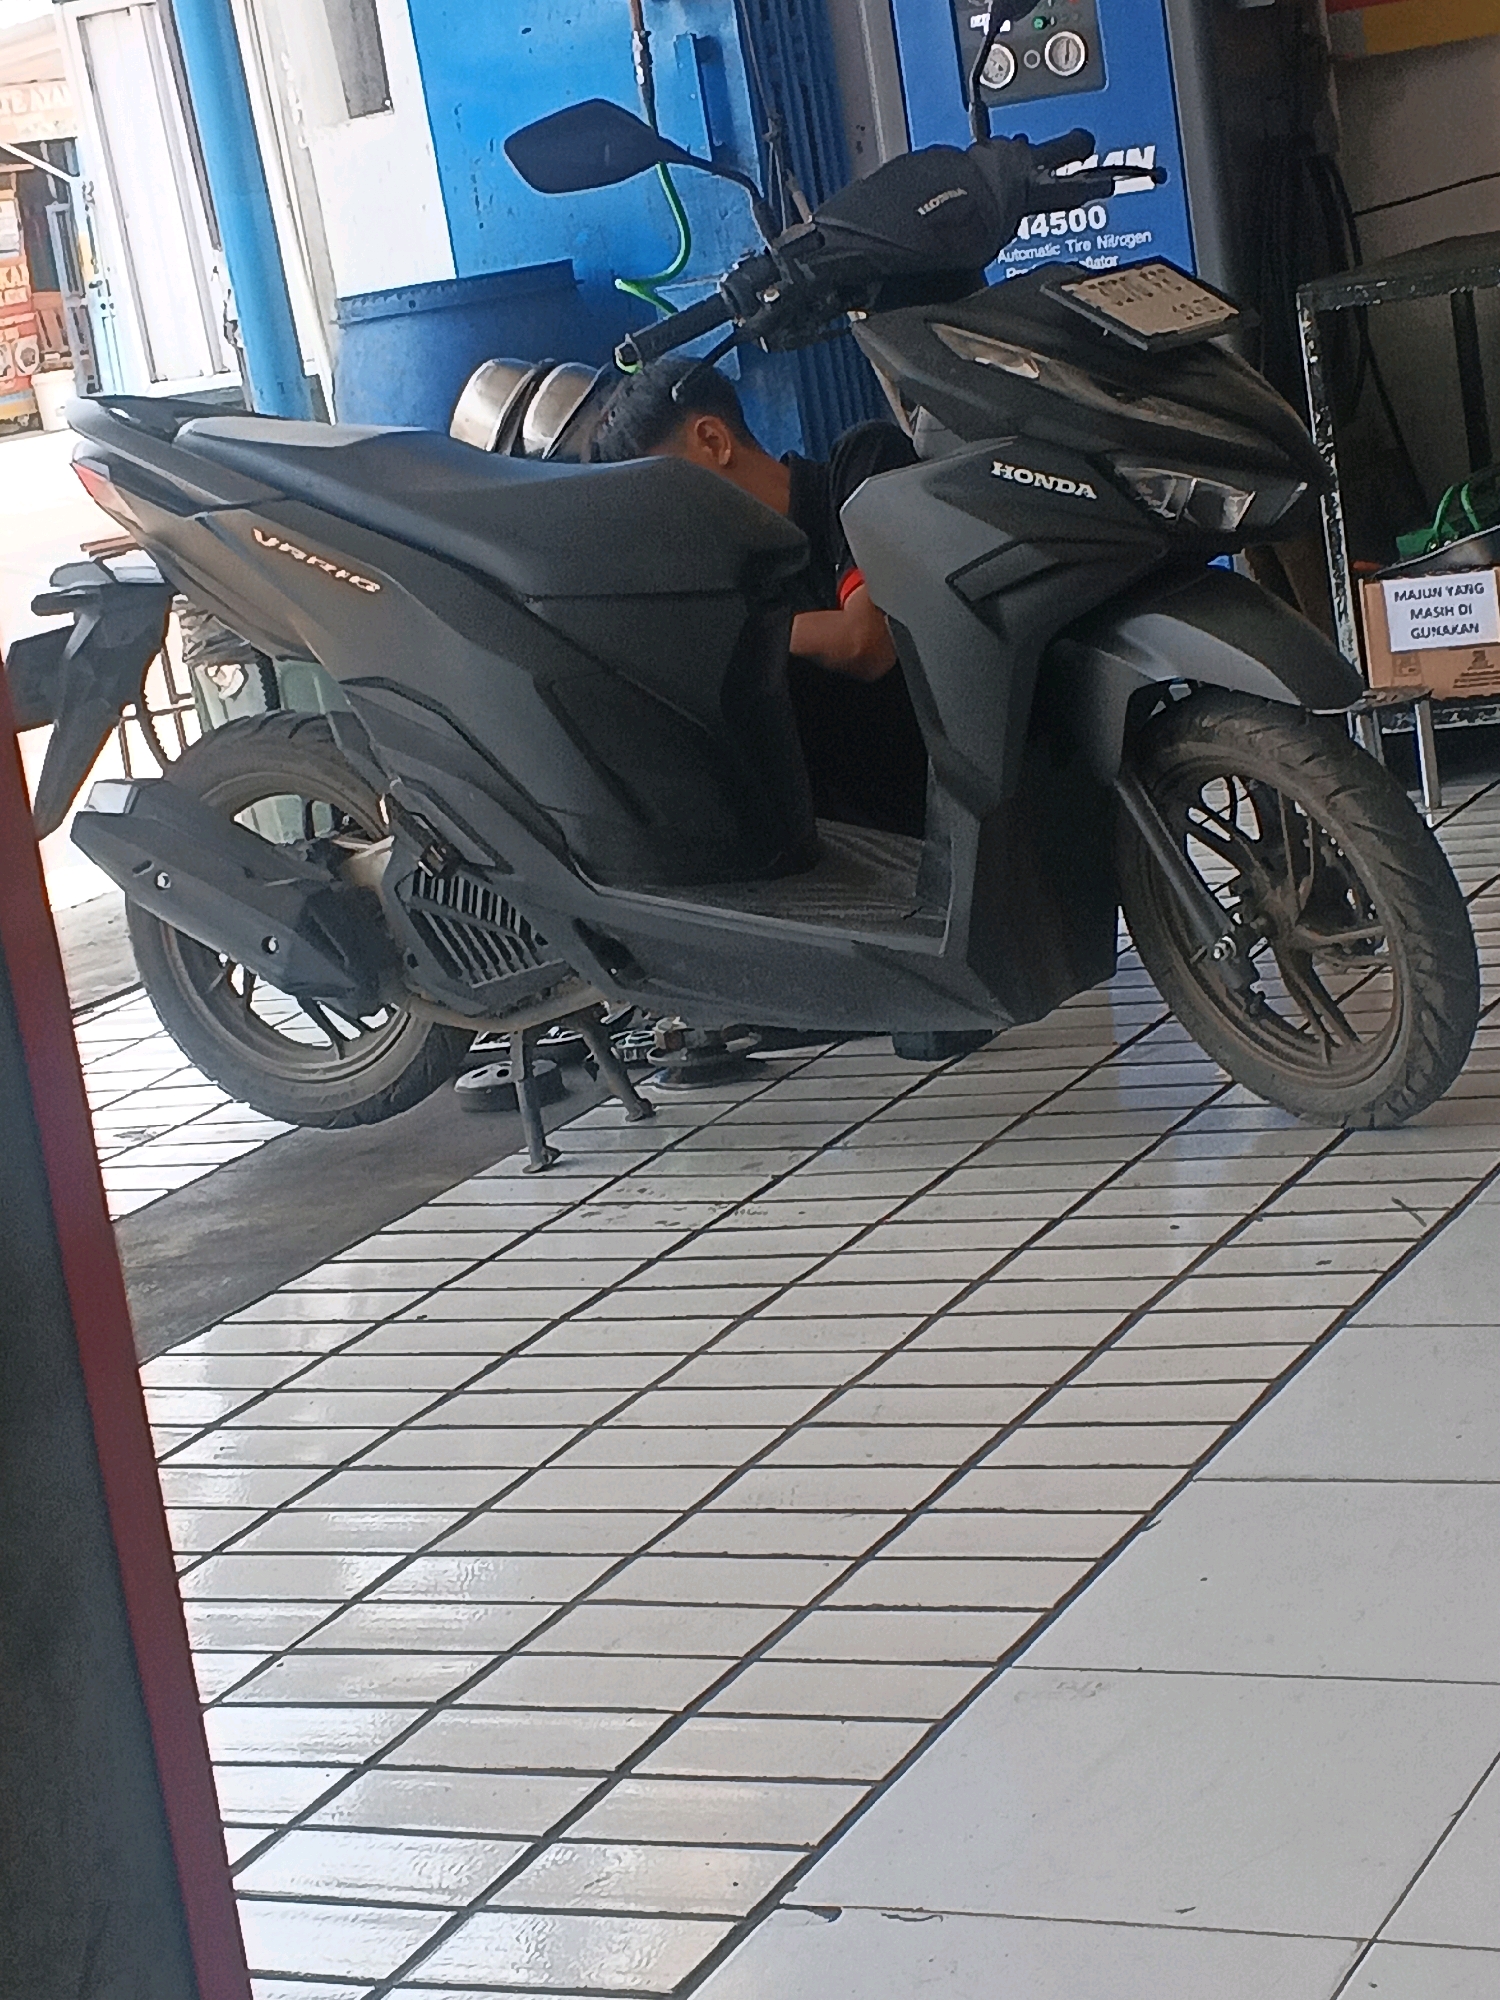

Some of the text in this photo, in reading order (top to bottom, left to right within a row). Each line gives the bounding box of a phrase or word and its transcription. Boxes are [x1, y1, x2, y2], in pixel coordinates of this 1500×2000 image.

[998, 231, 1152, 263] Automatic Tire Nitrogen
[991, 461, 1098, 500] HONDA
[253, 528, 381, 593] VARIO
[1394, 583, 1485, 602] MAJUN YANG
[1410, 603, 1473, 620] MASIH DI
[1410, 623, 1480, 640] GUNAKAN
